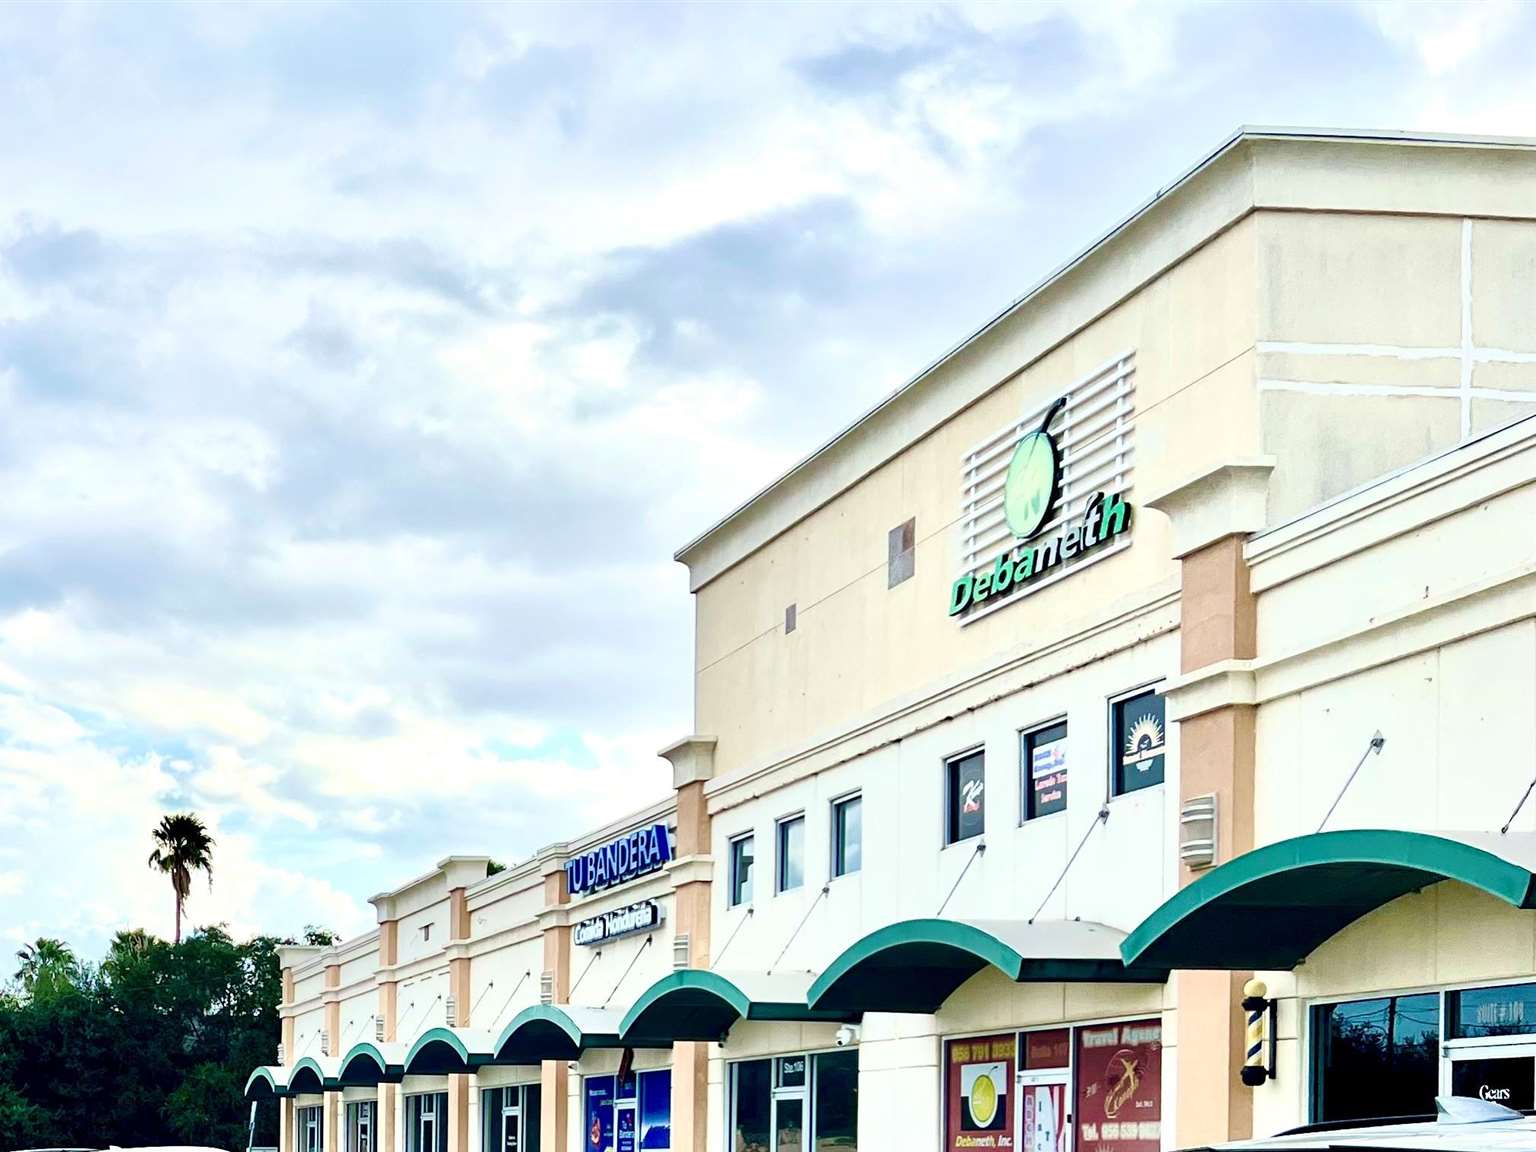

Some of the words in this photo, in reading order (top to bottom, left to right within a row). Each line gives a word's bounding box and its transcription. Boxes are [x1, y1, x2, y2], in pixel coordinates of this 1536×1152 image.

[949, 492, 1131, 617] Debaneth
[565, 857, 583, 894] TU
[587, 826, 661, 886] BANDERA
[575, 920, 604, 945] Comida
[1082, 1027, 1119, 1048] Travel
[1121, 1025, 1162, 1046] Agenc
[1479, 1085, 1511, 1101] Gears
[955, 1135, 997, 1149] Debaneth,
[998, 1135, 1013, 1147] Inc.
